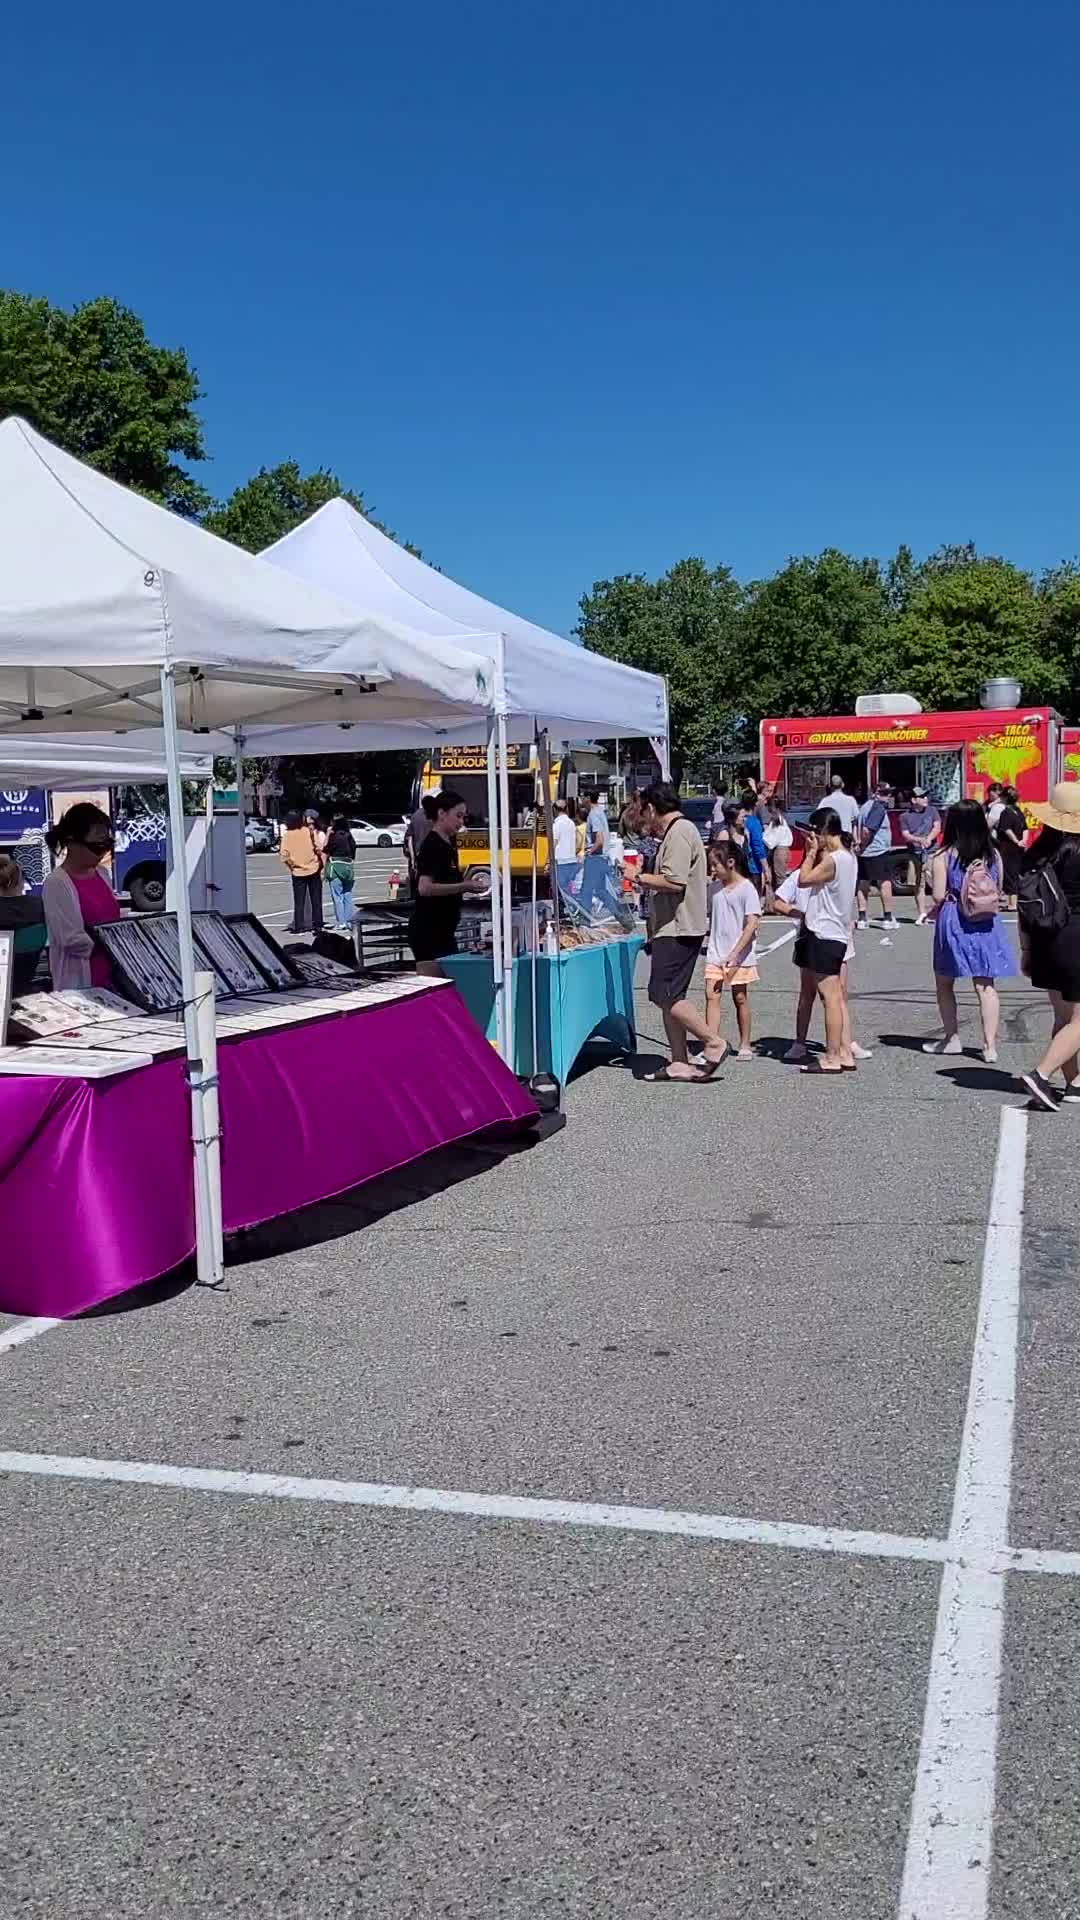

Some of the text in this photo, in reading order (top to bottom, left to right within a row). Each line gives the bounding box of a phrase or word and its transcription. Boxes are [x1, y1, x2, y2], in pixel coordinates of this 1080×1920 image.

[1004, 724, 1031, 735] TACO
[998, 736, 1037, 748] SAURUS
[440, 758, 517, 768] LOUKOUMES
